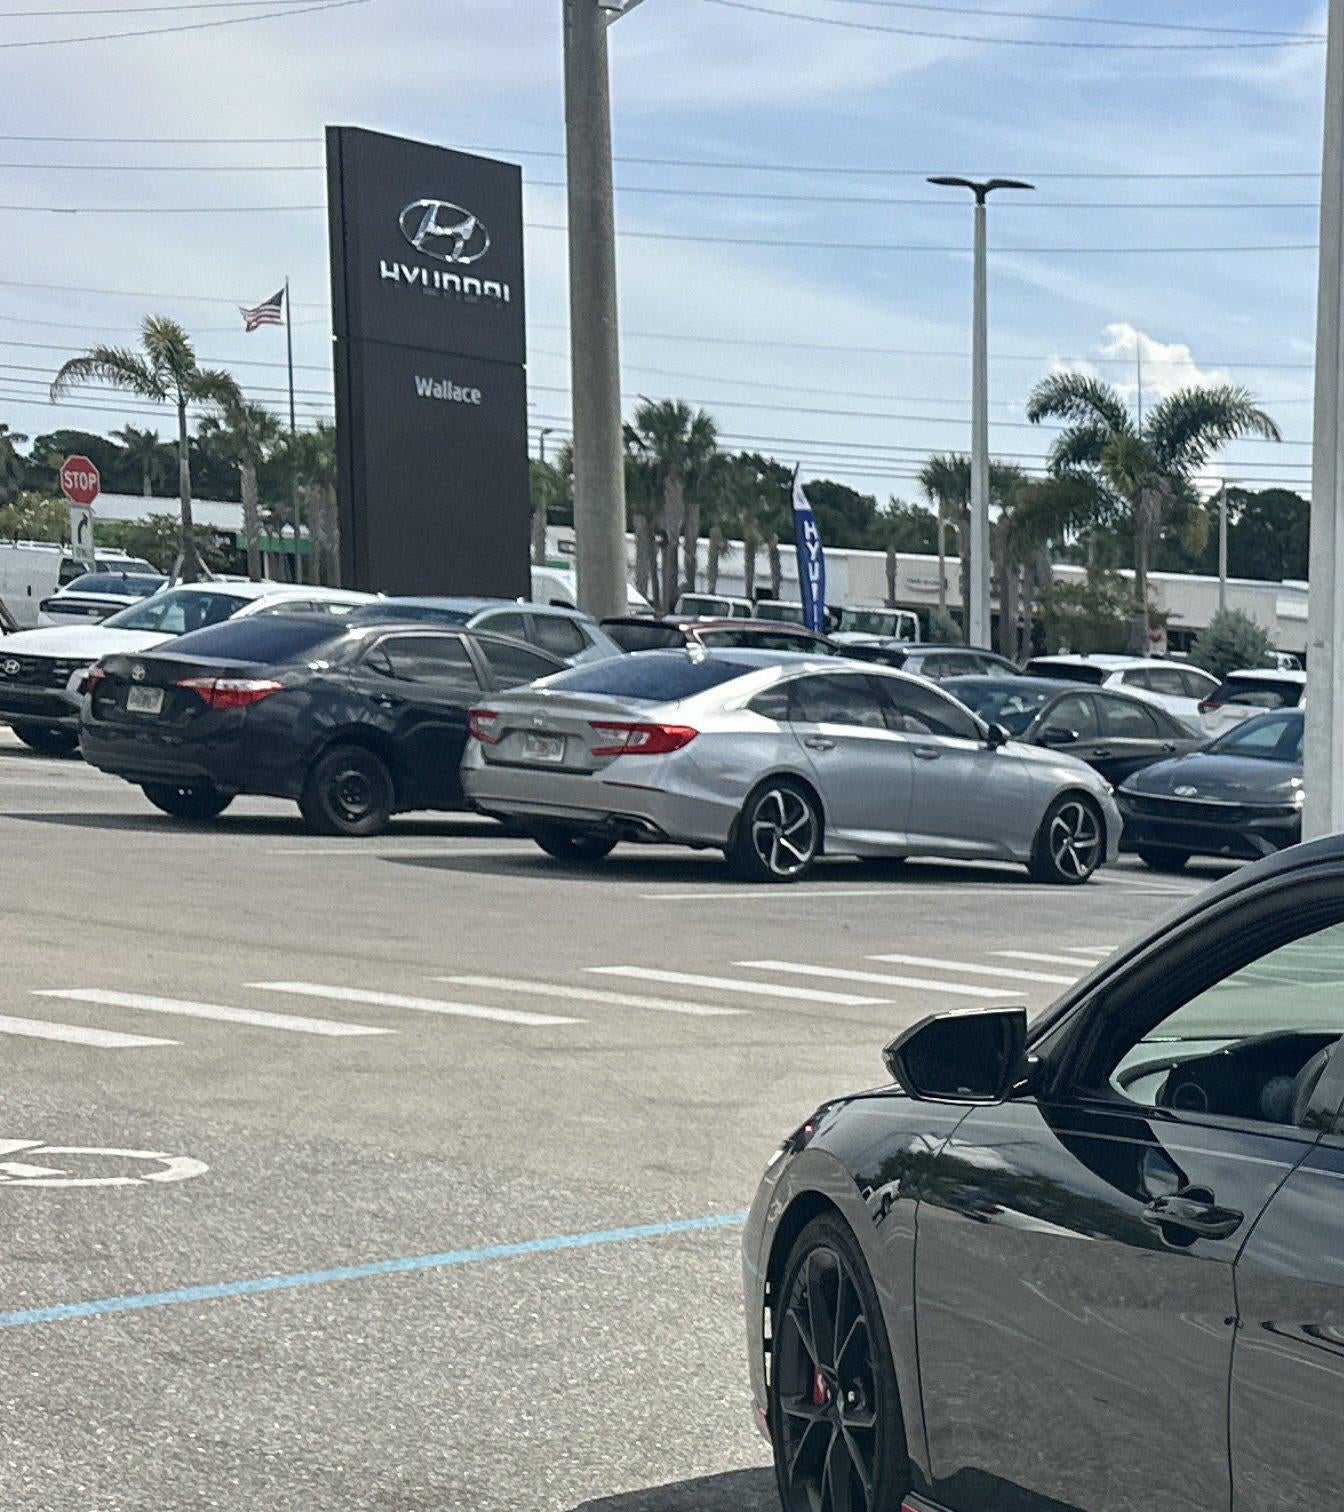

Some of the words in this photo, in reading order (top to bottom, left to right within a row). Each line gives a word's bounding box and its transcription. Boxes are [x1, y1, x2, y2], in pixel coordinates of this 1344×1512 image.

[379, 259, 511, 305] HYUNDAI
[414, 374, 482, 405] Wallace
[63, 470, 97, 490] STOP
